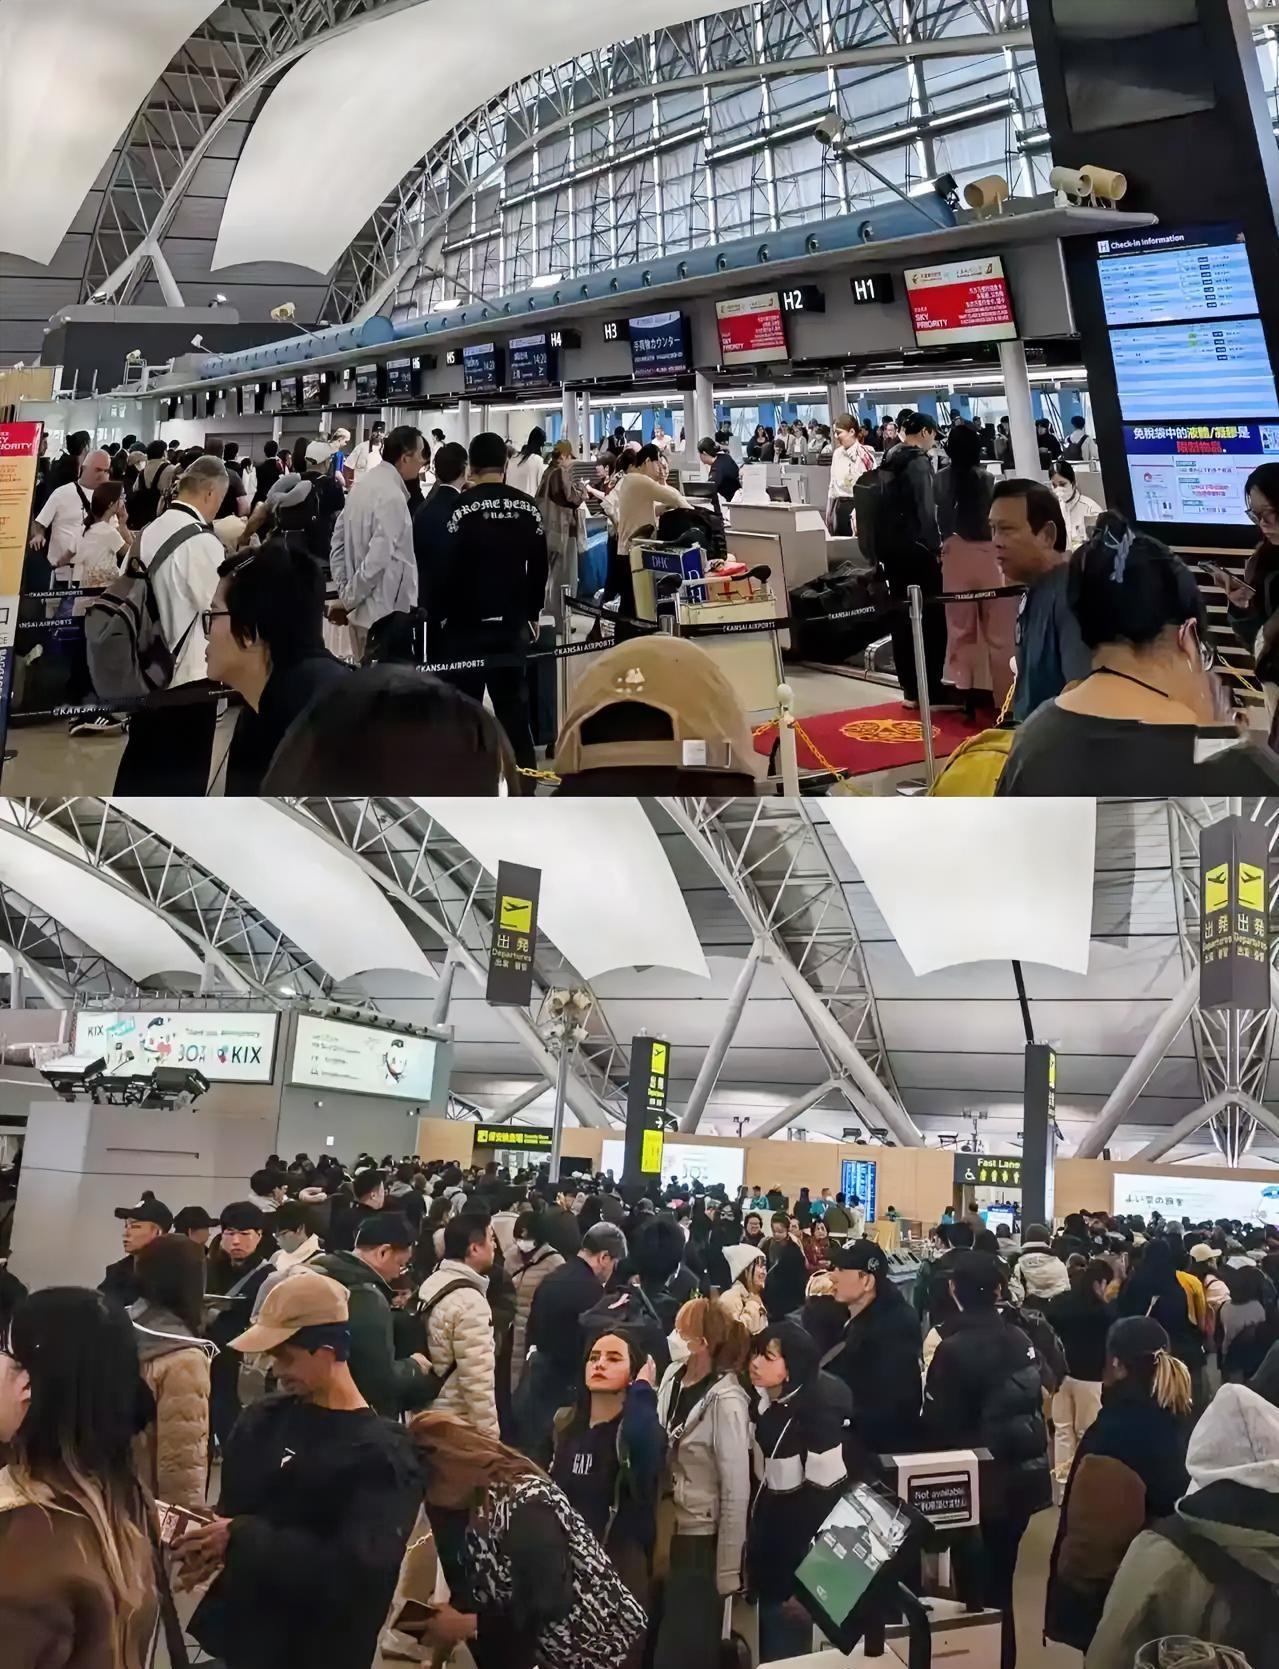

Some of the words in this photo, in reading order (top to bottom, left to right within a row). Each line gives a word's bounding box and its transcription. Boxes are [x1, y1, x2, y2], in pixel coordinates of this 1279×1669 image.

[854, 278, 875, 301] H1
[783, 289, 804, 311] H2
[914, 313, 929, 321] SKY
[551, 331, 562, 347] H4
[604, 322, 618, 340] H3
[726, 623, 749, 633] KANSAI
[558, 646, 583, 655] KANSAI
[583, 638, 615, 652] AIRPORTS
[421, 664, 449, 673] KANSAI
[449, 659, 485, 671] AIRPORTS
[1204, 914, 1229, 939] 出発
[1237, 913, 1265, 938] 出発
[497, 934, 529, 953] 出発
[491, 947, 532, 962] Departures
[88, 1025, 104, 1036] KIX
[231, 1046, 262, 1064] KIX
[977, 1158, 997, 1168] Fast
[999, 1160, 1021, 1169] Lane
[572, 1453, 593, 1475] GAP
[914, 1490, 929, 1500] Not
